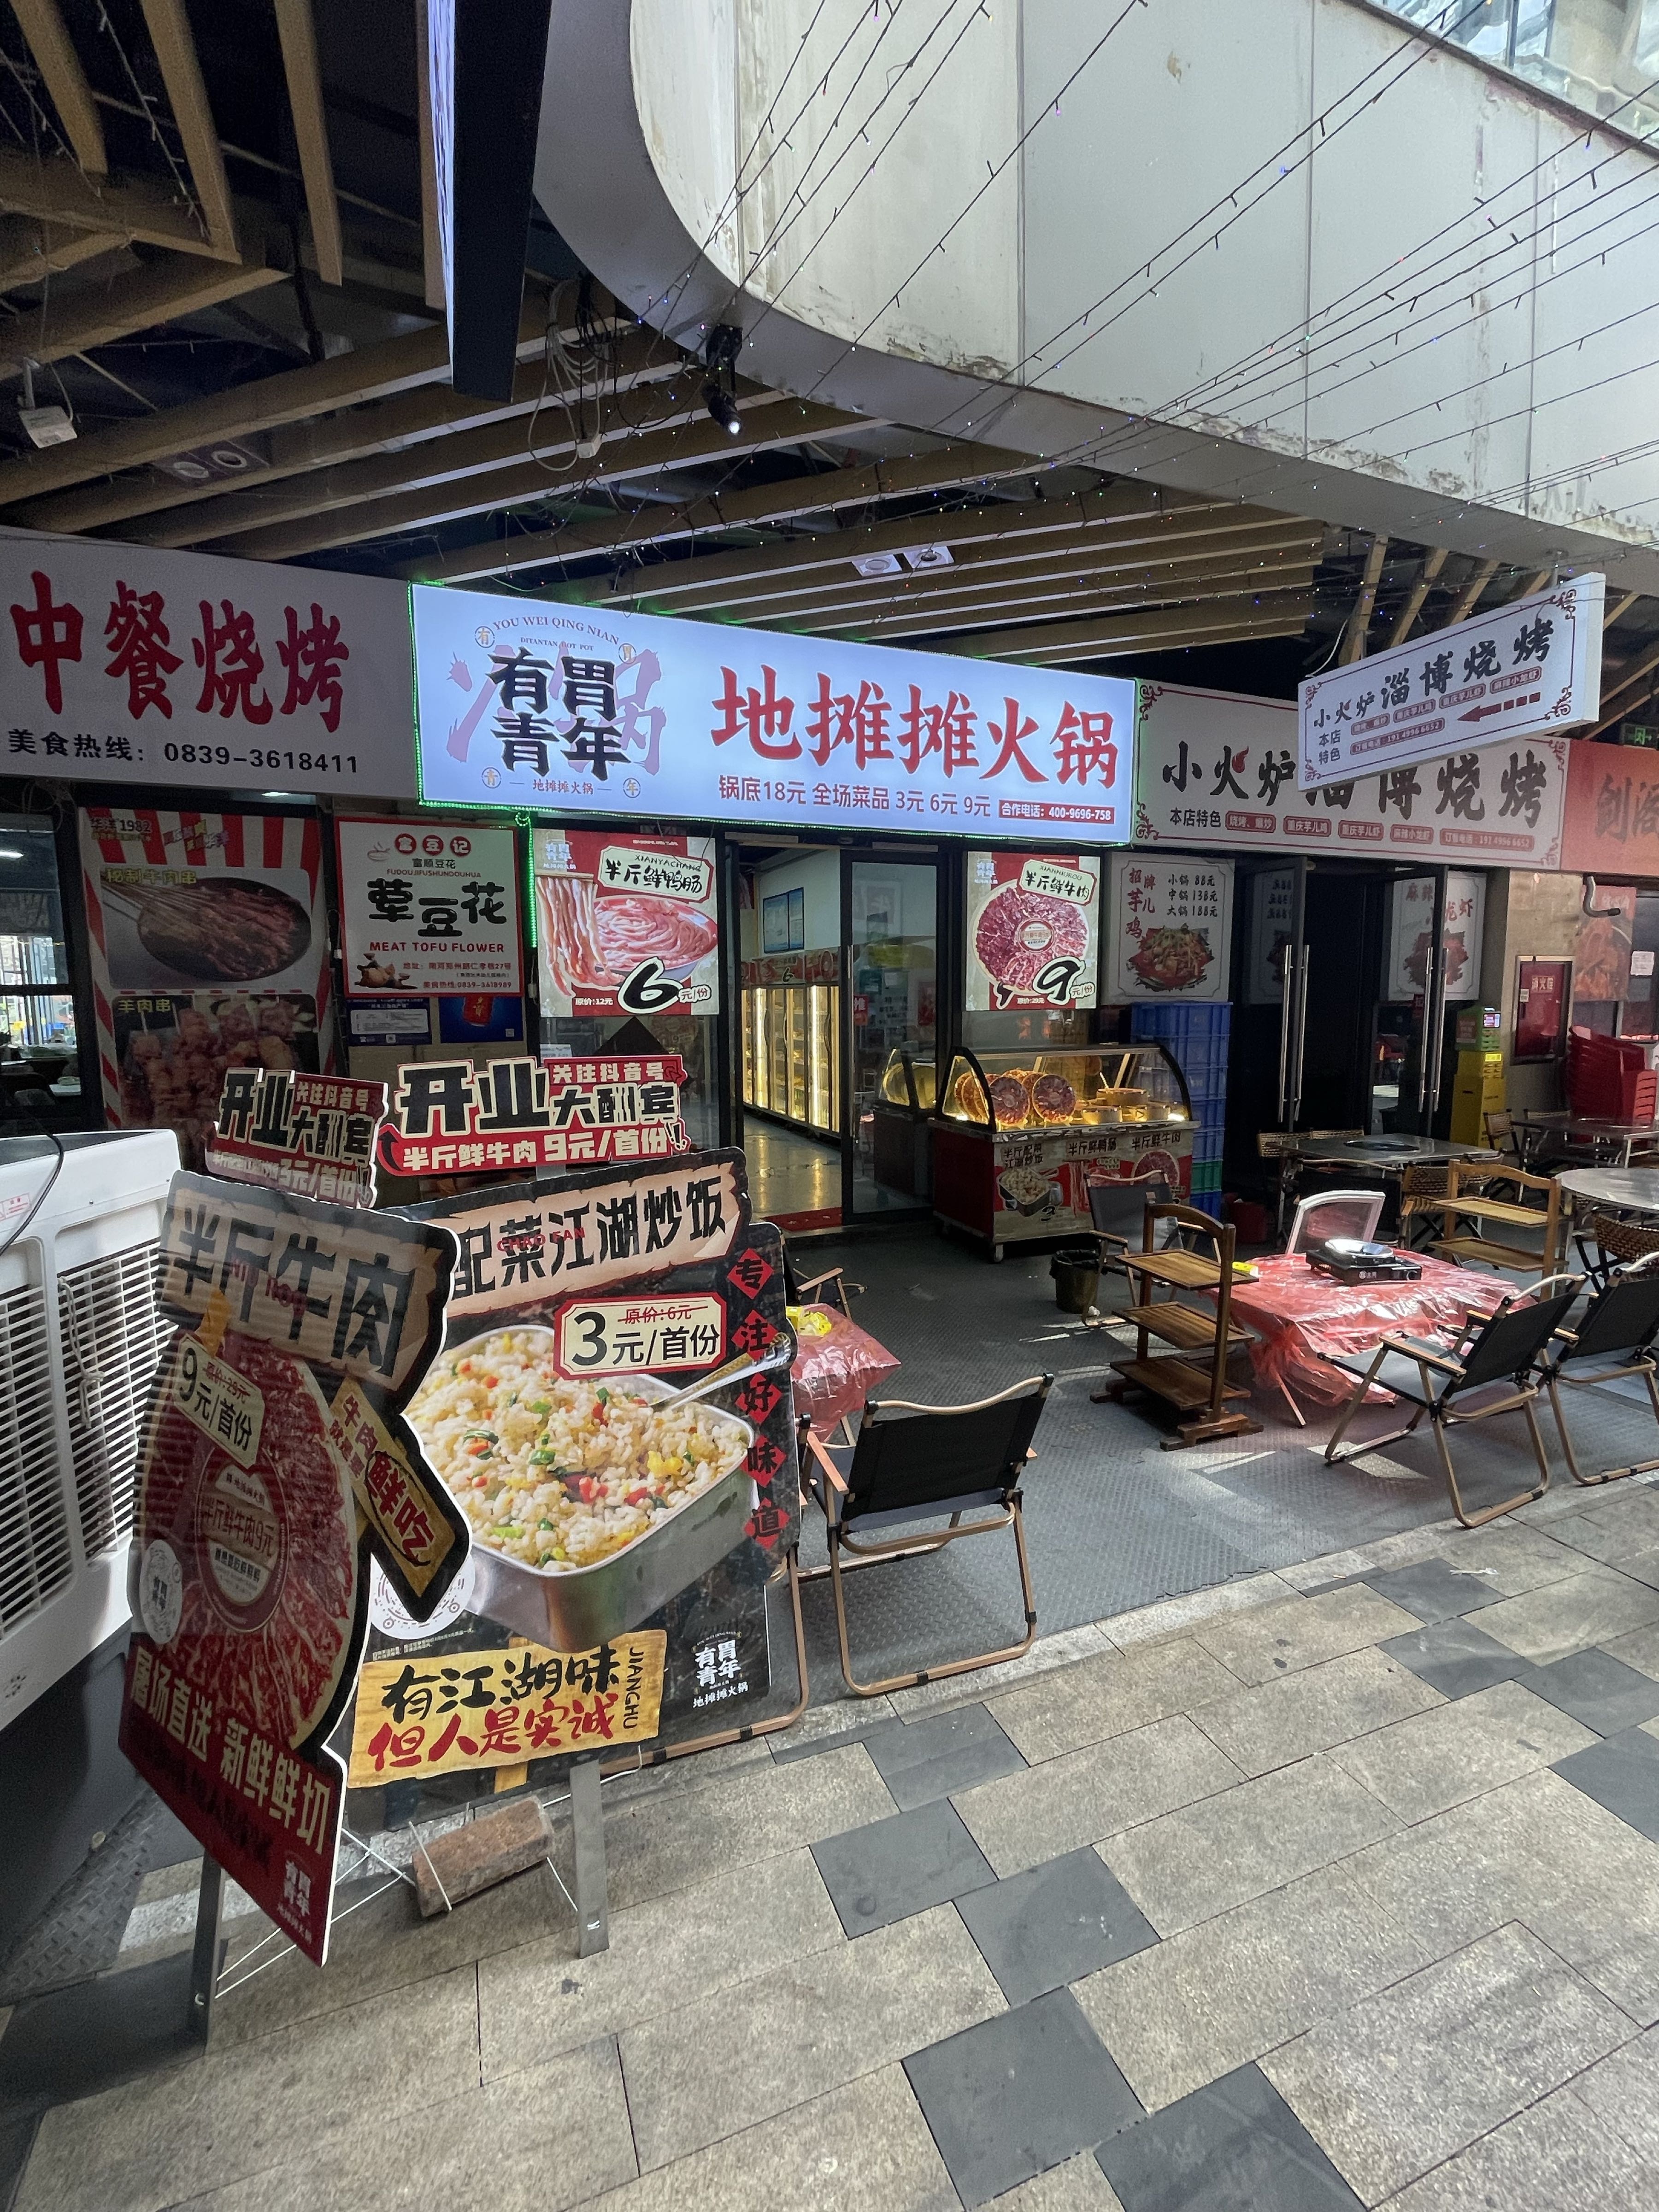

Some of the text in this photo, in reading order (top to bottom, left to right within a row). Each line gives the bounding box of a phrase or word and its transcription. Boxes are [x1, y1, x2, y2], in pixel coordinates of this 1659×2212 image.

[493, 616, 619, 645] YOU WEI QING NIAN
[520, 636, 558, 647] DITANTAN
[580, 643, 594, 652] POT
[10, 571, 349, 733] 中餐烧烤
[711, 664, 1119, 789] 地摊摊火锅
[1319, 730, 1341, 746] 本店
[1319, 749, 1341, 765] 特色
[532, 779, 594, 795] 地摊摊火锅
[719, 775, 991, 818] 锅底18元 全场菜品 3元 6元 9元
[1170, 807, 1221, 828] 本店特色
[605, 859, 703, 894] 半斤鲜鸭肠
[1024, 870, 1090, 901] 半斤鲜牛肉
[367, 878, 507, 937] 荤豆花
[369, 941, 504, 953] MEAT TOFU FLOWER
[623, 963, 678, 1009] 6
[1037, 960, 1080, 1001] 9
[553, 1062, 665, 1083] 关注抖音号
[296, 1081, 369, 1111] 关注抖音号
[403, 1127, 668, 1171] 半斤鲜牛肉 9元/首份
[497, 1227, 586, 1253] CHAO FAN
[173, 1201, 415, 1378] 半斤牛肉
[382, 1642, 619, 1724] 有江湖味
[622, 1646, 644, 1730] JIANGHU
[369, 1693, 619, 1772] 但人是实诚
